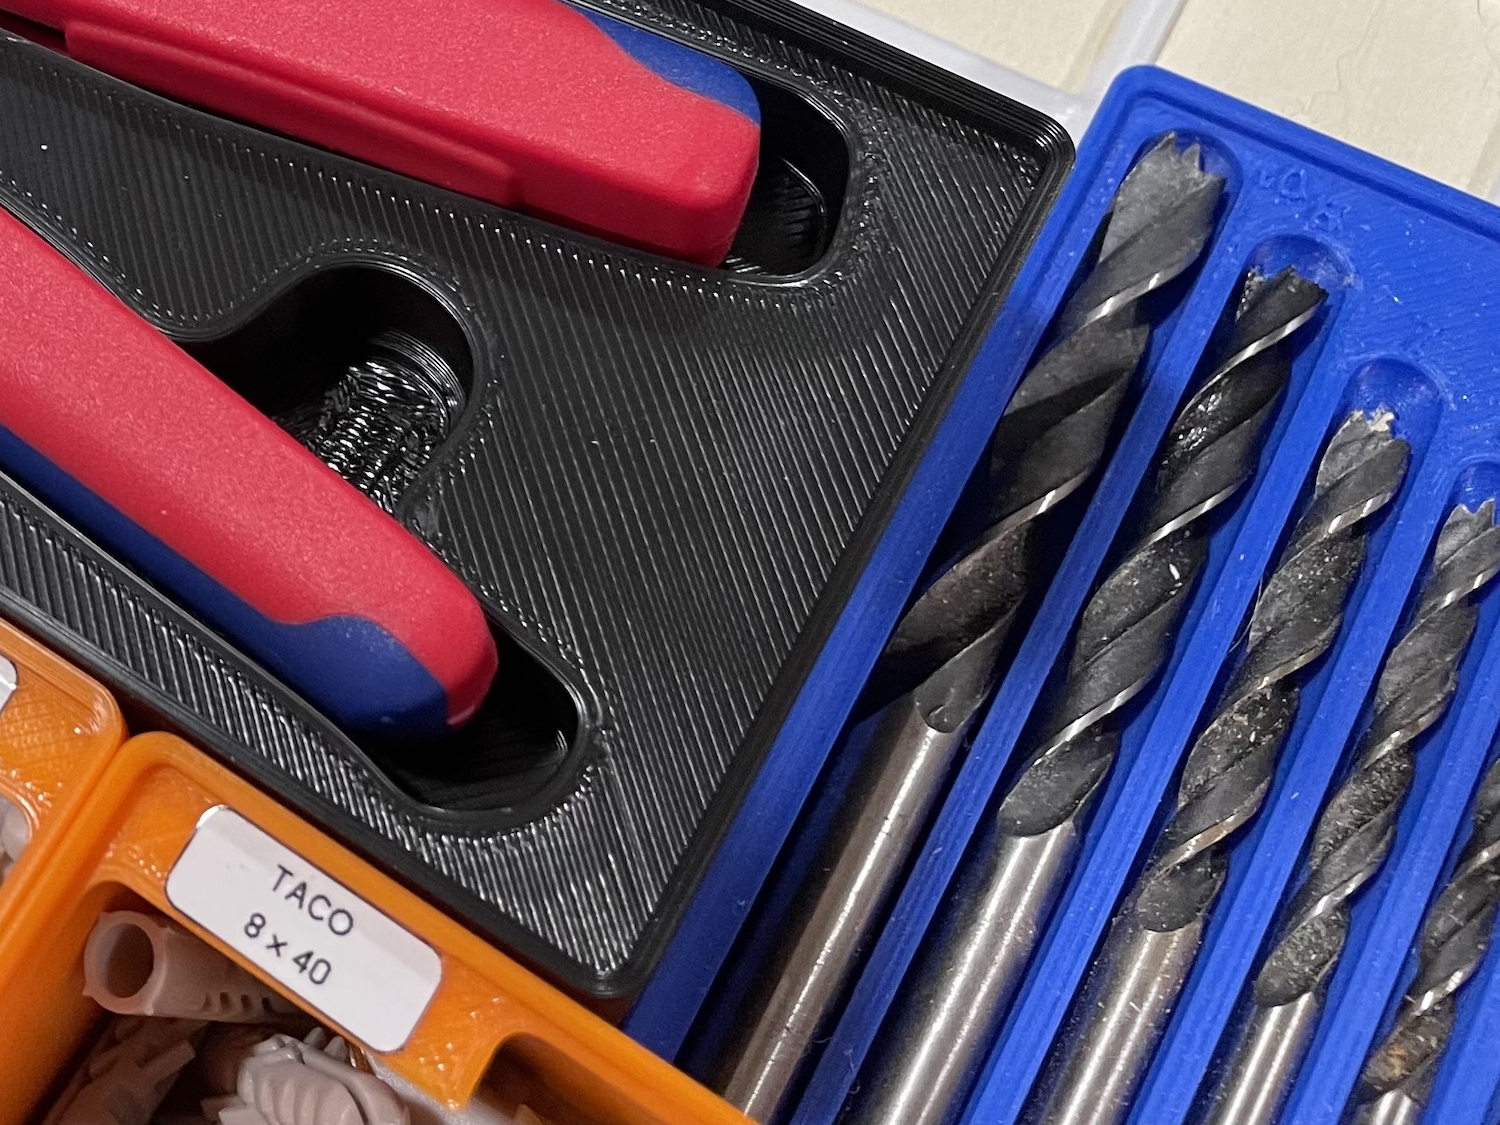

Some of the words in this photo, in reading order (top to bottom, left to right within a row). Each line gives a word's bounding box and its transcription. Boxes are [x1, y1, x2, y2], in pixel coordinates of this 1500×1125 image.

[272, 864, 353, 936] TACO
[244, 913, 267, 938] 8
[292, 950, 332, 985] 40
